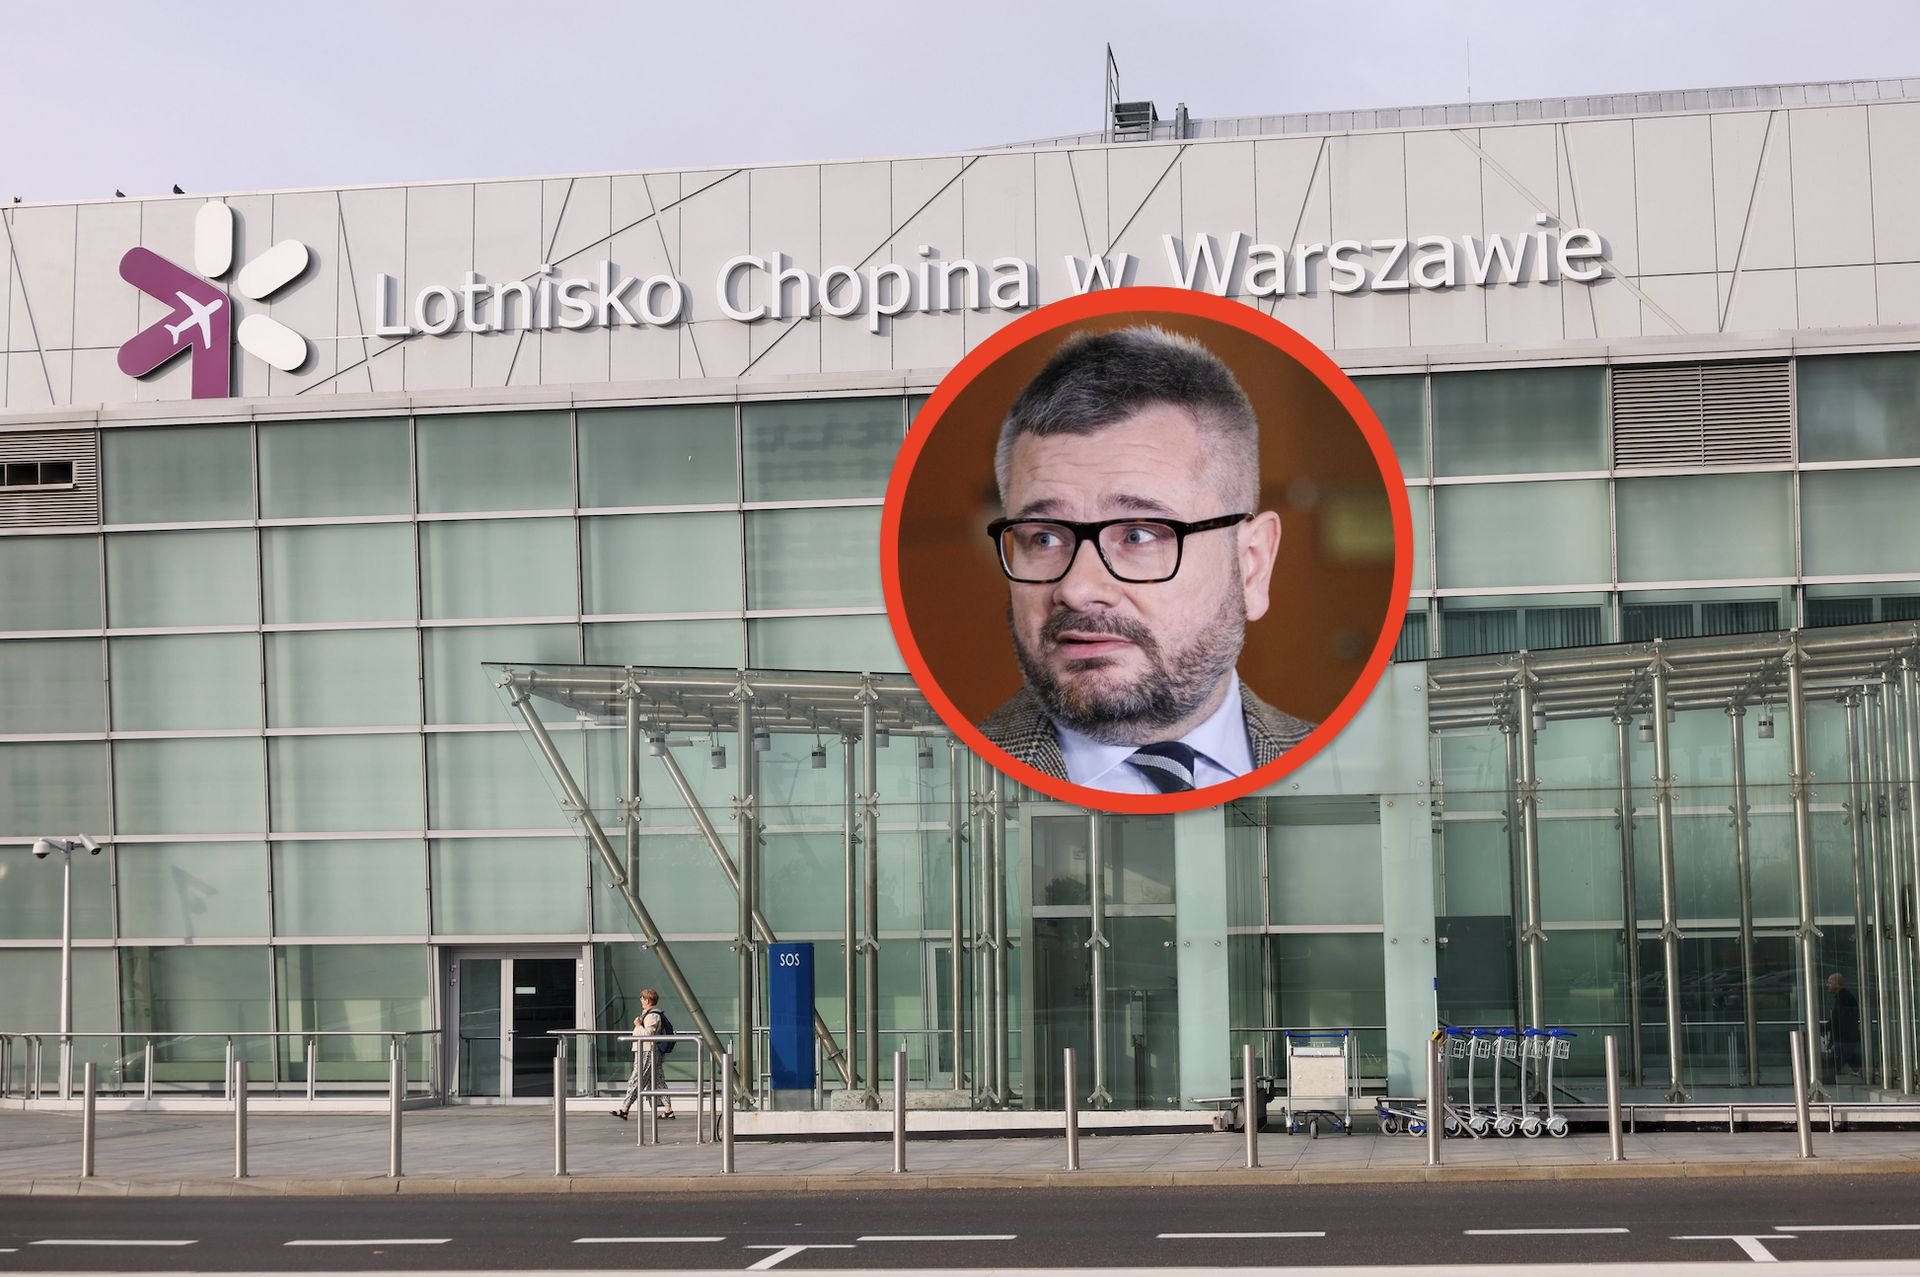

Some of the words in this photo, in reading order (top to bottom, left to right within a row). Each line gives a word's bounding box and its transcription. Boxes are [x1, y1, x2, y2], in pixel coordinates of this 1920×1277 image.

[376, 259, 685, 337] Lotnisko
[717, 245, 1030, 333] Chopina
[1064, 253, 1131, 293] w
[1162, 213, 1603, 298] Warszawie
[779, 953, 800, 966] SOS
